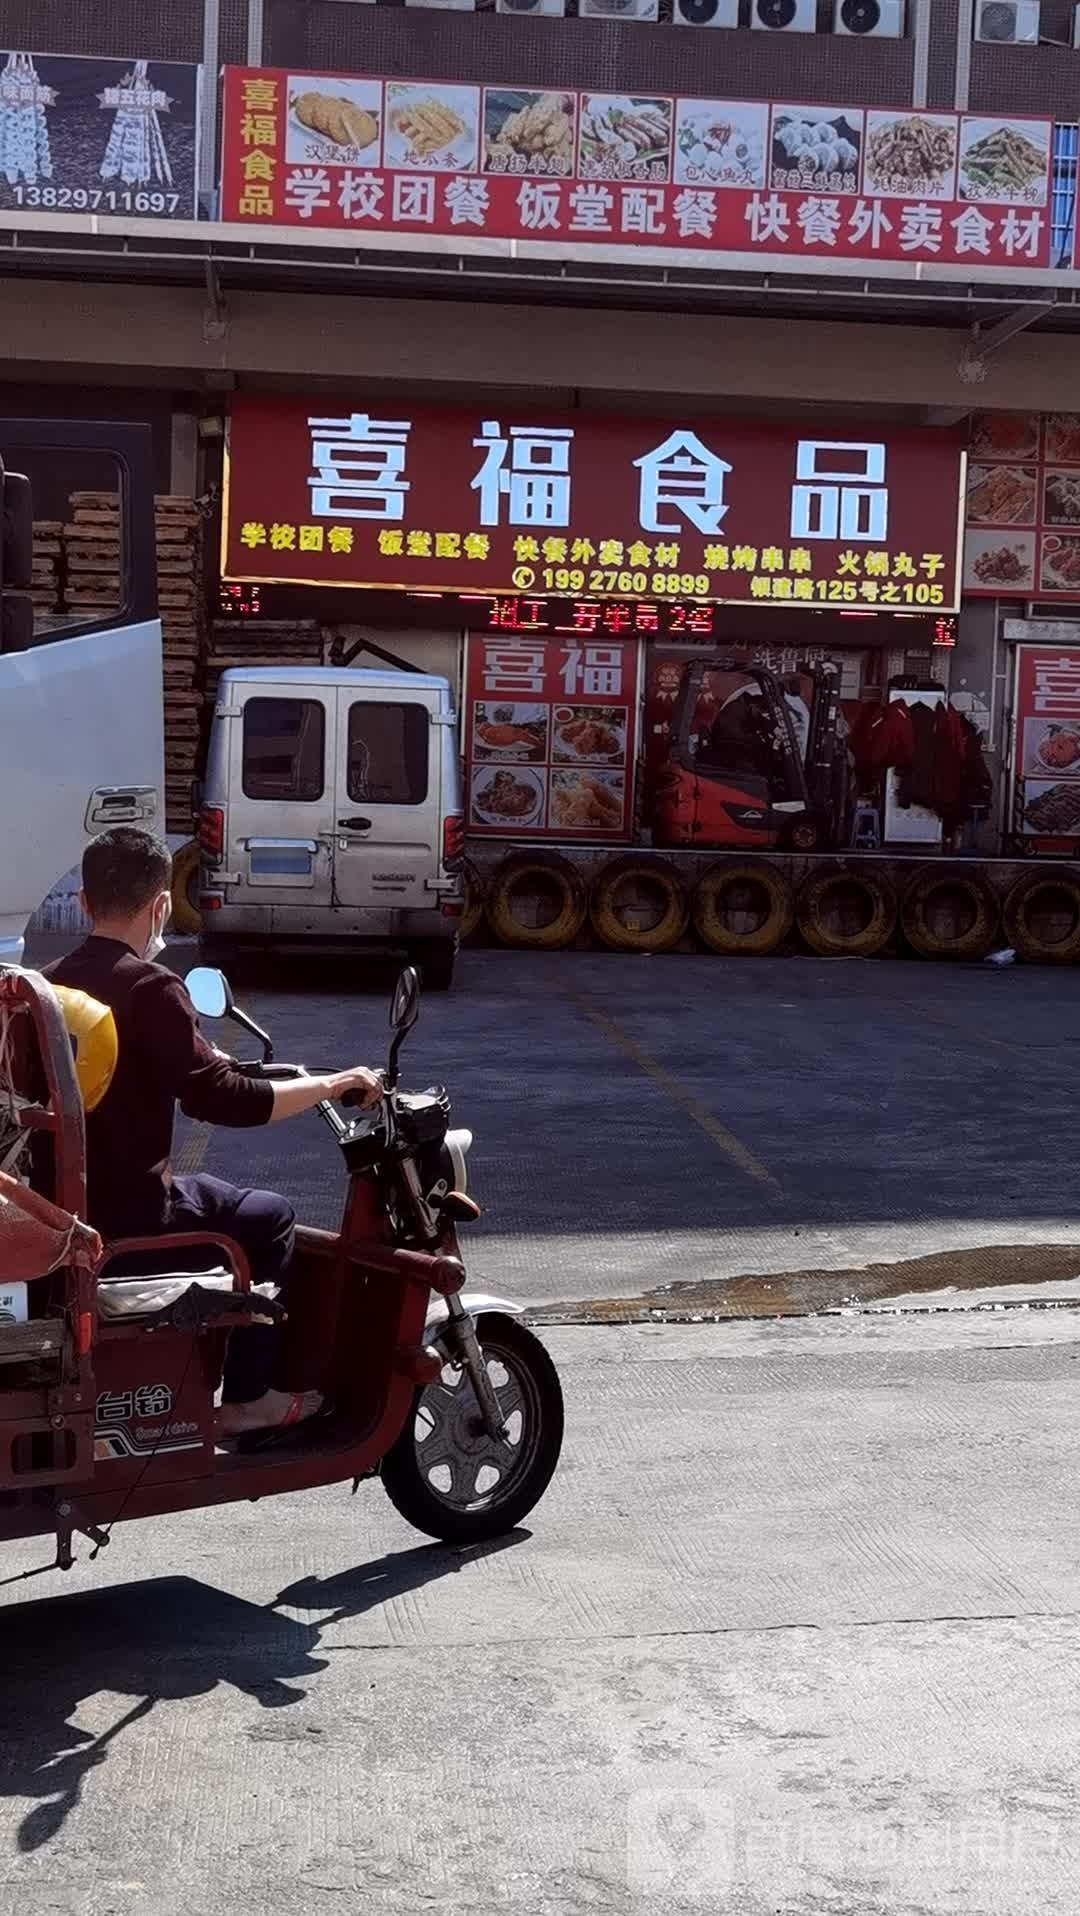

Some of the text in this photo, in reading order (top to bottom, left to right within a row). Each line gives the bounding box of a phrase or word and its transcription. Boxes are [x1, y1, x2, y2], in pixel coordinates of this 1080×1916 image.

[239, 78, 279, 216] 喜福食品
[583, 159, 667, 181] 黑胡椒香肠
[685, 165, 756, 185] 包心鱼丸
[872, 177, 945, 195] 蚝油肉片
[13, 186, 180, 213] 13829711697
[966, 183, 1039, 201] 孜然牛柳
[285, 168, 1045, 258] 学校团餐 饭堂配餐 快餐外卖食材
[307, 413, 888, 542] 喜福食品
[240, 522, 945, 580] 学校团餐 饭堂配餐 快餐外卖食材 烧烤串串 火锅丸子
[543, 568, 710, 595] 199 2760 8899
[481, 636, 625, 696] 喜福
[96, 1384, 172, 1423] 台铃
